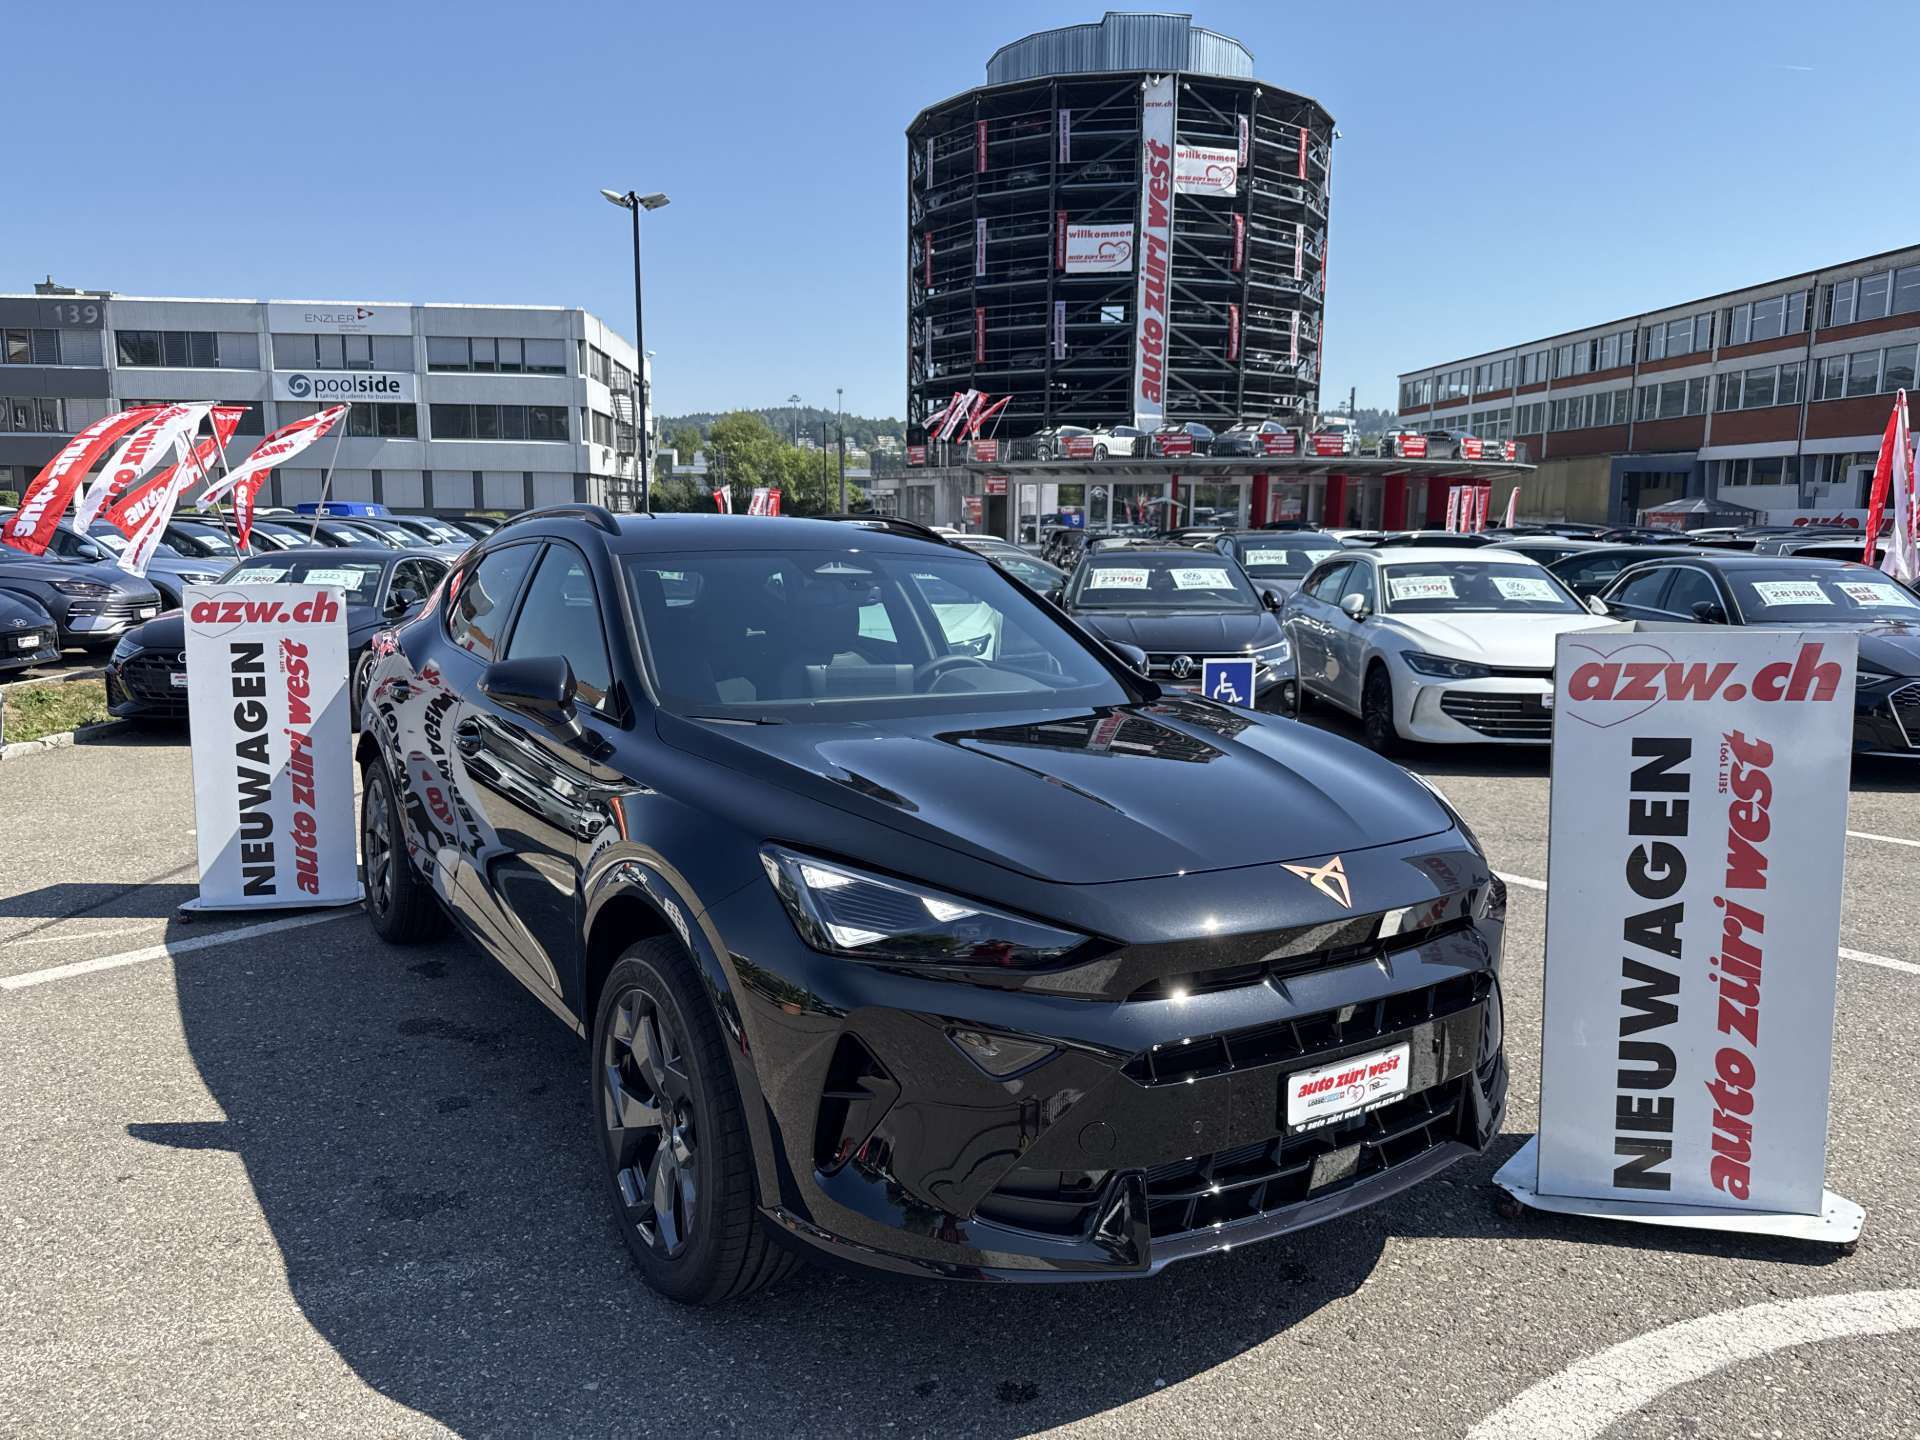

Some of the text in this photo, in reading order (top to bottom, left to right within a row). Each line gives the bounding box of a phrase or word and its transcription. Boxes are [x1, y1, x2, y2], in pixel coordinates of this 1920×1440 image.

[1177, 149, 1236, 163] willkommen
[1068, 229, 1132, 239] willkommen
[1139, 138, 1170, 404] auto züri west
[52, 304, 98, 324] 139
[304, 312, 356, 324] ENZLER
[314, 374, 401, 399] poolside
[190, 591, 339, 624] azw.ch
[1567, 642, 1842, 702] azw.ch
[229, 642, 277, 897] NEUWAGEN
[280, 637, 319, 896] auto züri west
[1718, 742, 1730, 794] SEIT 1991
[1612, 736, 1693, 1192] NEUWAGEN
[1702, 728, 1775, 1201] auto züri west
[1297, 1054, 1401, 1098] auto züri west
[1307, 1119, 1326, 1131] auto
